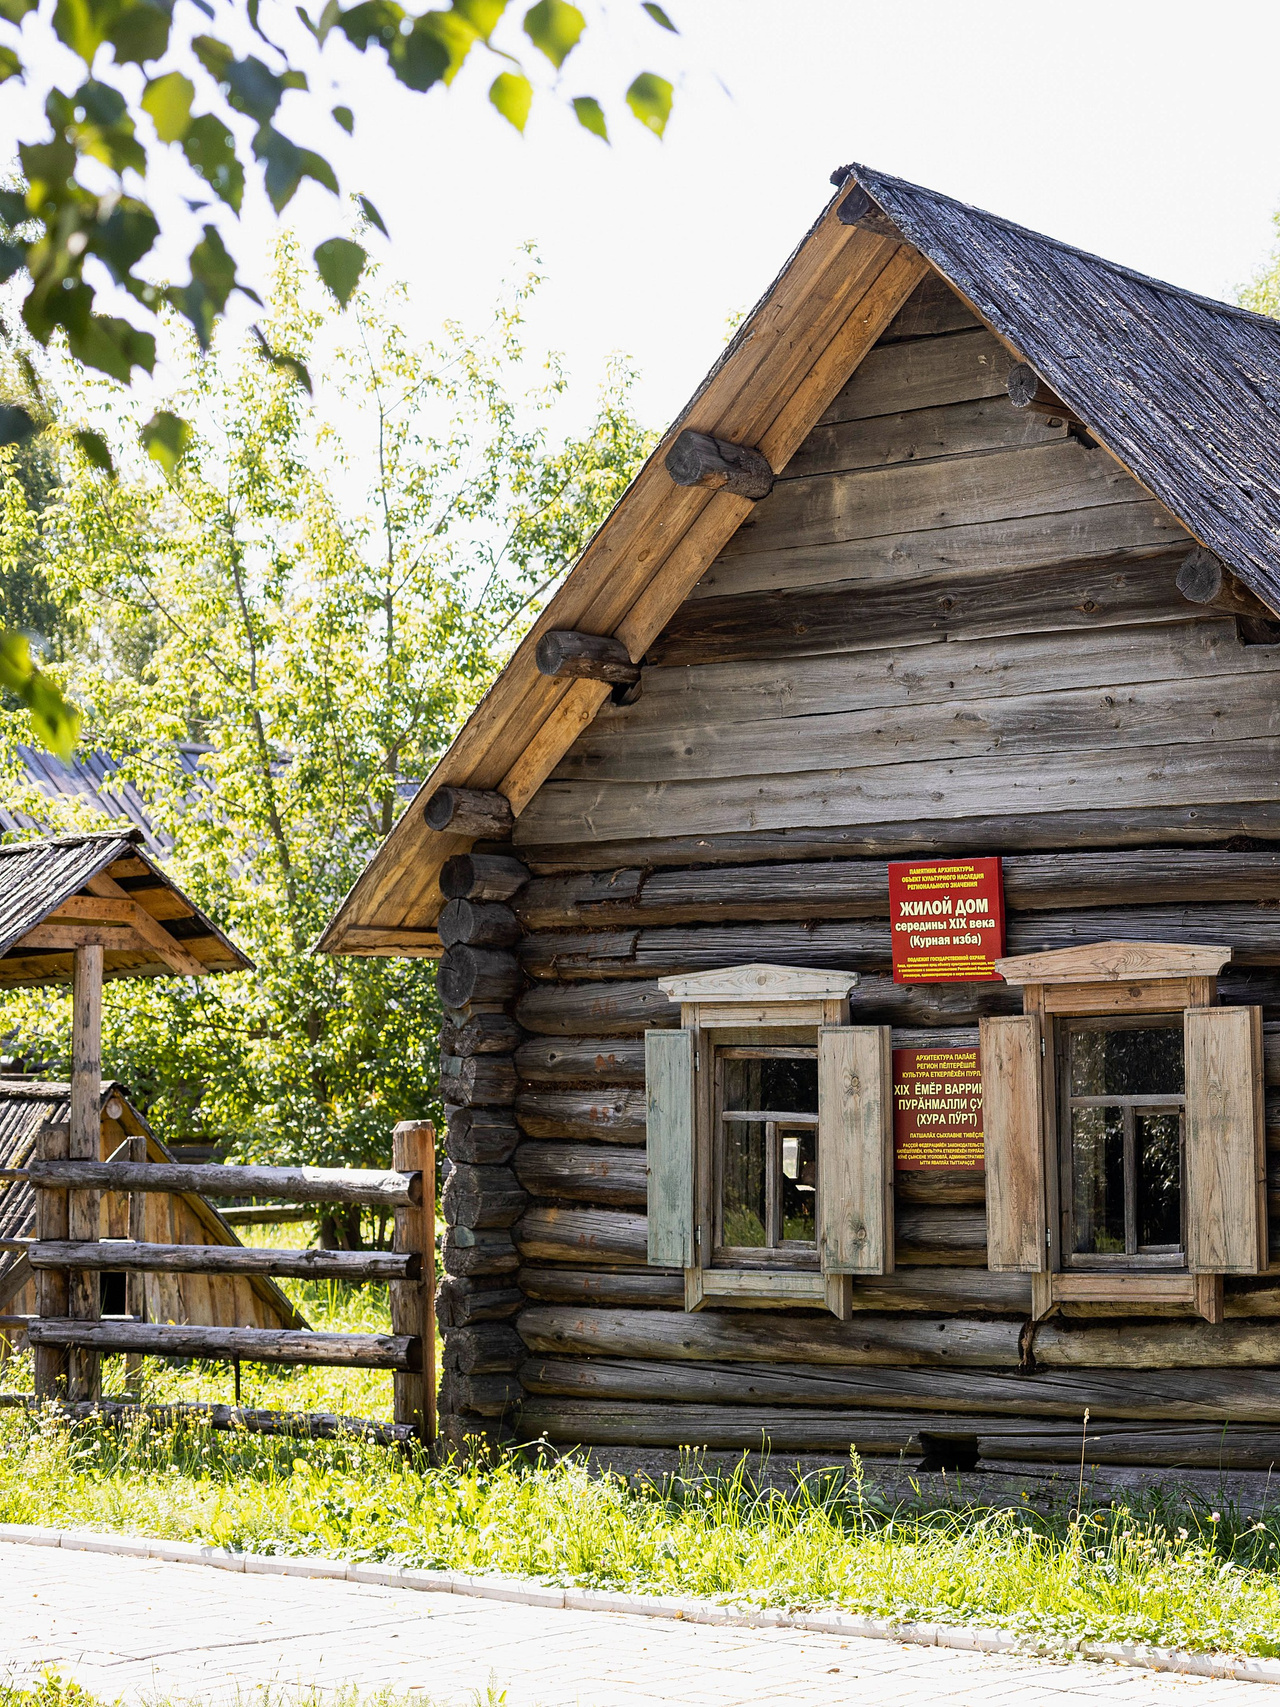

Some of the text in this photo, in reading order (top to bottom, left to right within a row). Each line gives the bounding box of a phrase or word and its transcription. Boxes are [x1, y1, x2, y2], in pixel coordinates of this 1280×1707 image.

[900, 896, 988, 916] ЖИЛОЙ ДОМ
[895, 918, 995, 933] середины XIX века
[910, 933, 981, 948] (Курная изба)
[894, 1085, 910, 1095] XIX
[917, 1113, 946, 1127] (ХУРА
